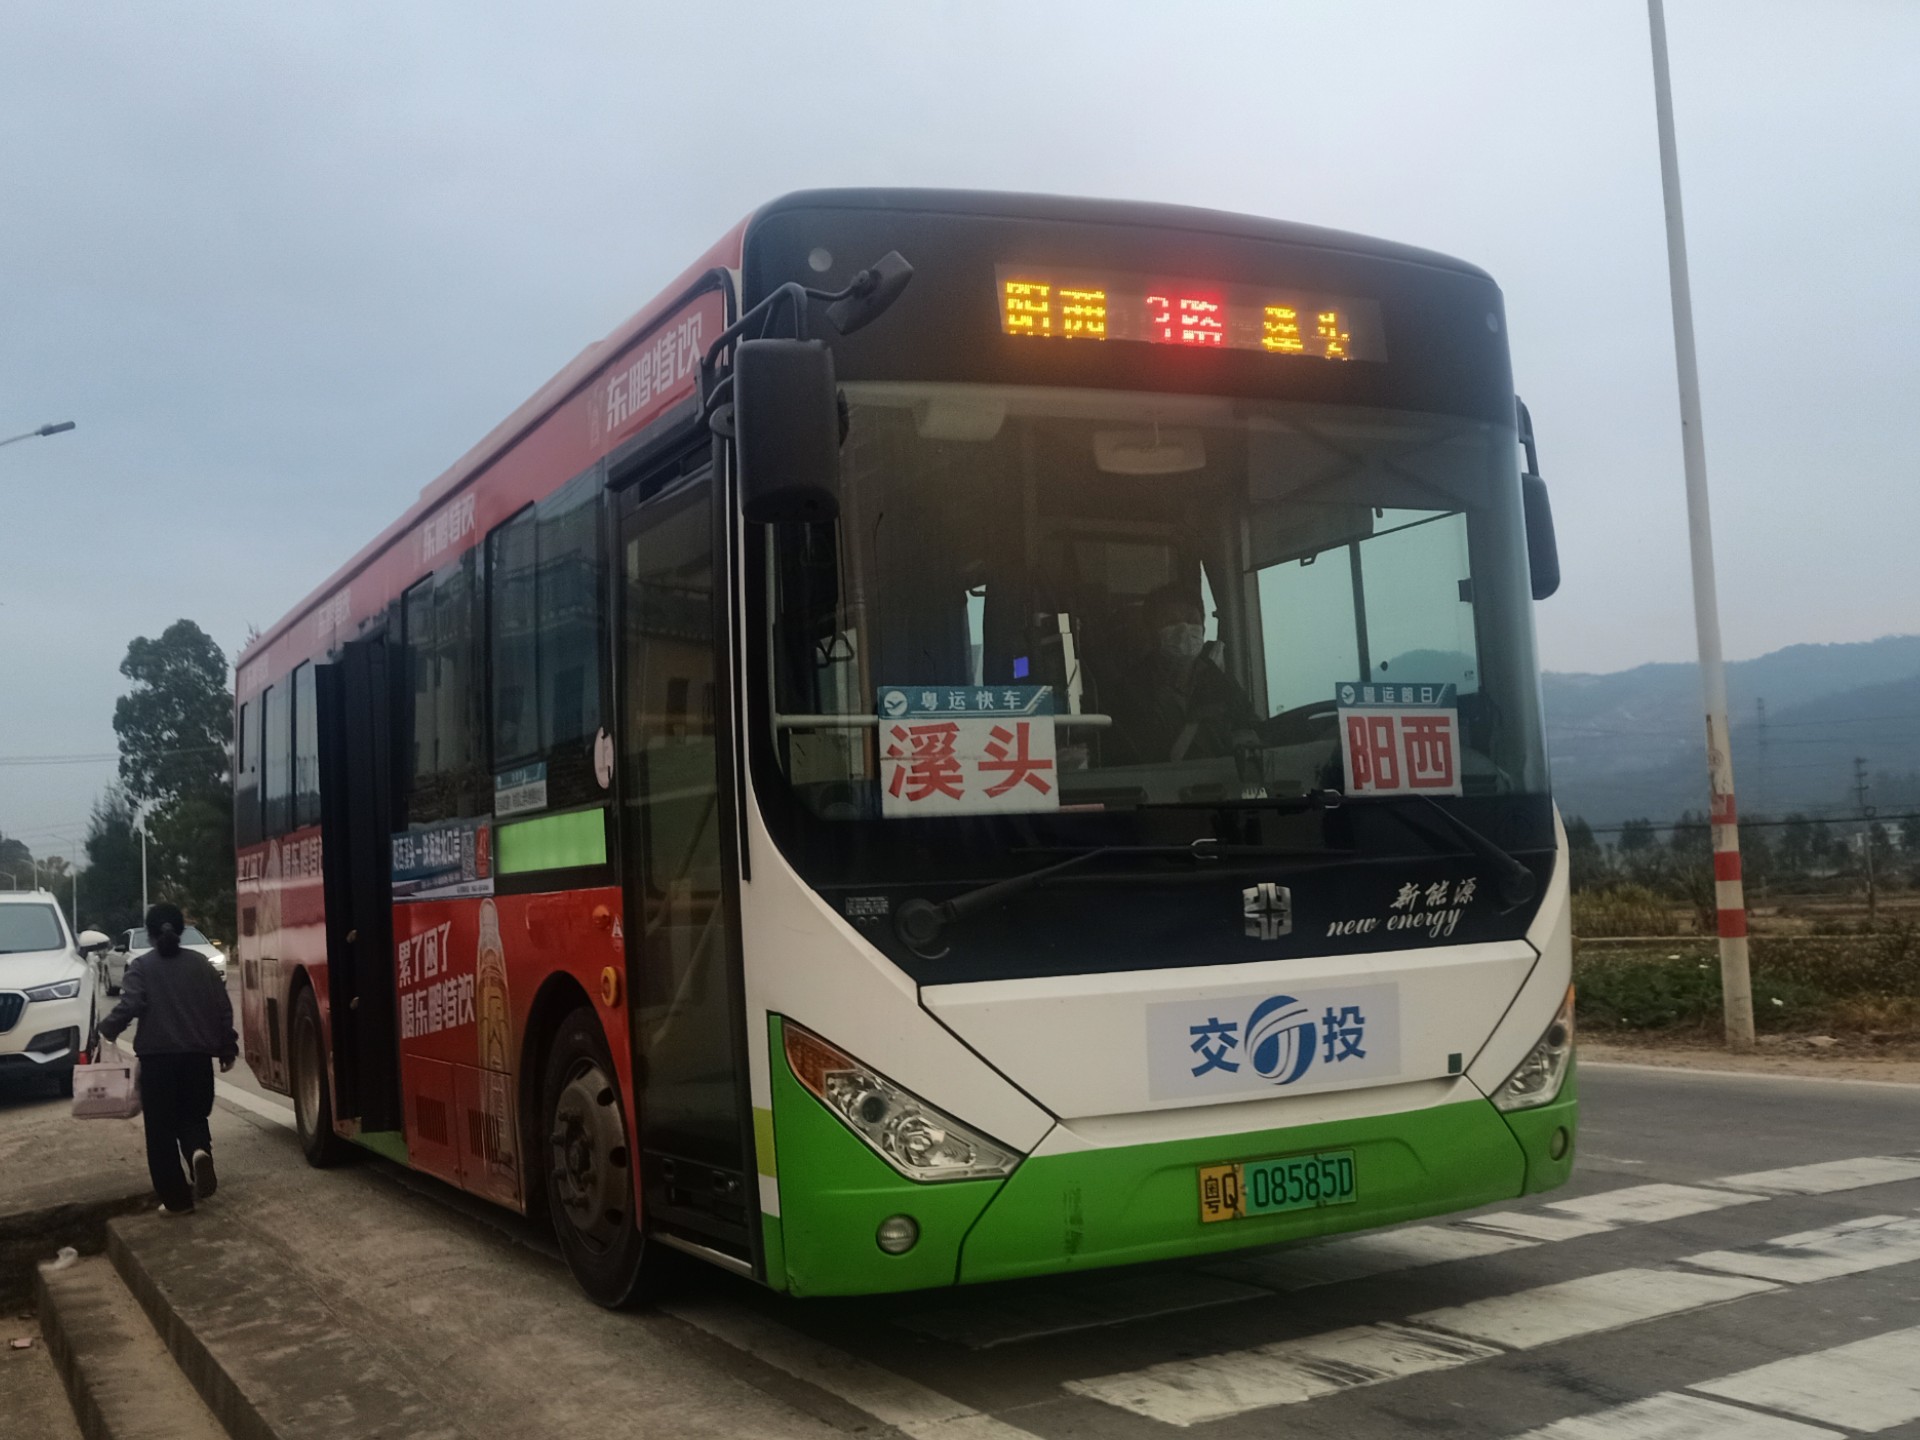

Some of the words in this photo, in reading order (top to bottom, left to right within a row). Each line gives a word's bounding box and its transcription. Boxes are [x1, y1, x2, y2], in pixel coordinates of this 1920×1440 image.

[606, 312, 703, 433] 东鹏特饮
[920, 690, 1022, 711] 粤运快车
[887, 721, 1053, 802] 溪头
[1346, 716, 1454, 790] 阳西
[1326, 916, 1382, 937] new
[1386, 907, 1464, 938] energy
[1390, 876, 1477, 912] 新能源
[398, 920, 452, 989] 累了困了
[400, 972, 476, 1040] 喝东鹏特饮
